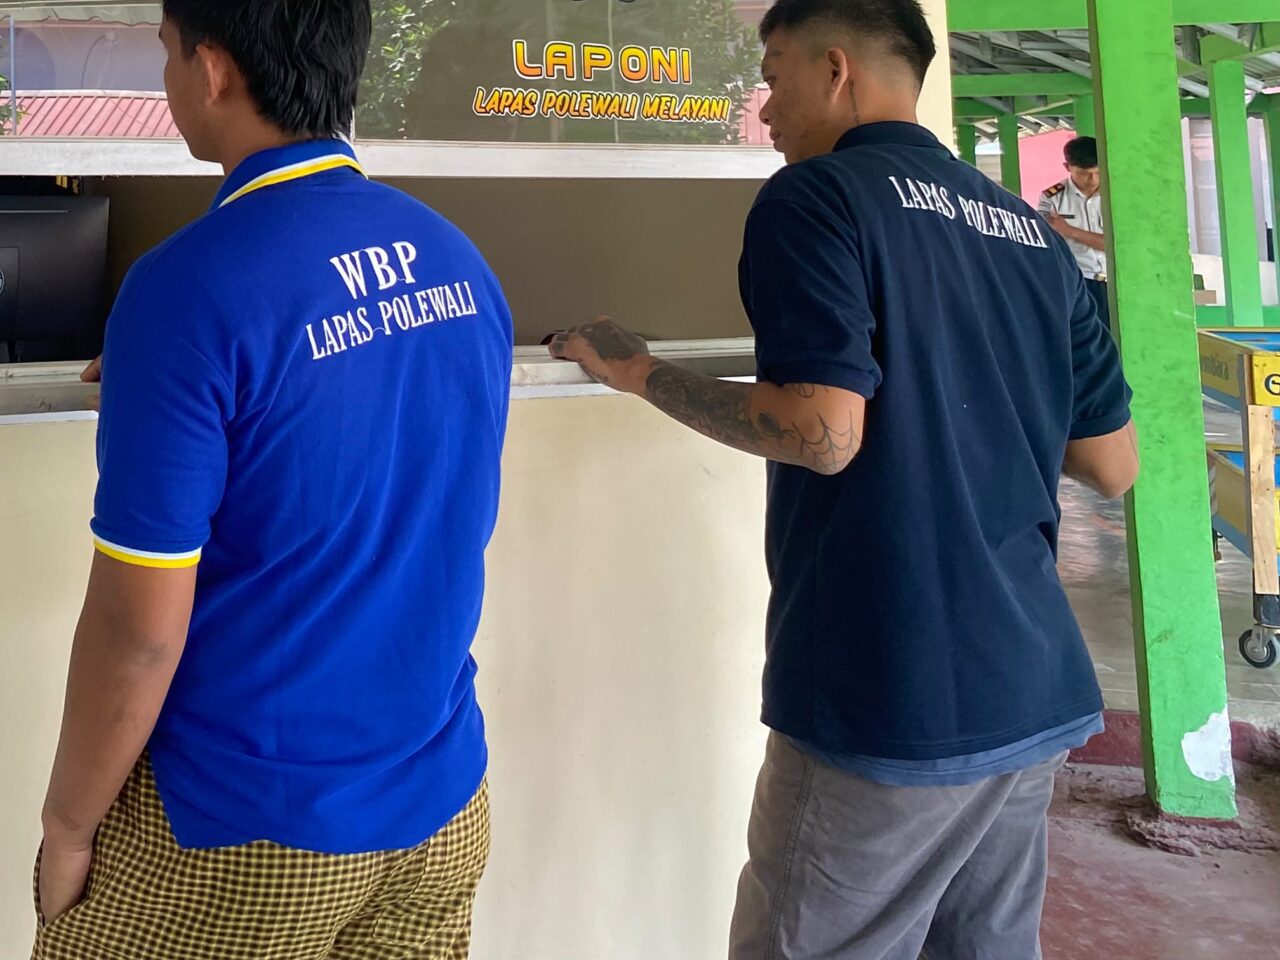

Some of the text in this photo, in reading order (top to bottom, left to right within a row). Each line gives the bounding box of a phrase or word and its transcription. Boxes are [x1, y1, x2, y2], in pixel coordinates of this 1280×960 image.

[513, 38, 693, 85] LAPONI
[473, 87, 731, 123] LAPAS POLEWALI MELAYANI
[888, 176, 1049, 249] LAPAS POLEWALI
[329, 240, 417, 300] WBP
[306, 281, 478, 360] LAPAS POLEWALI
